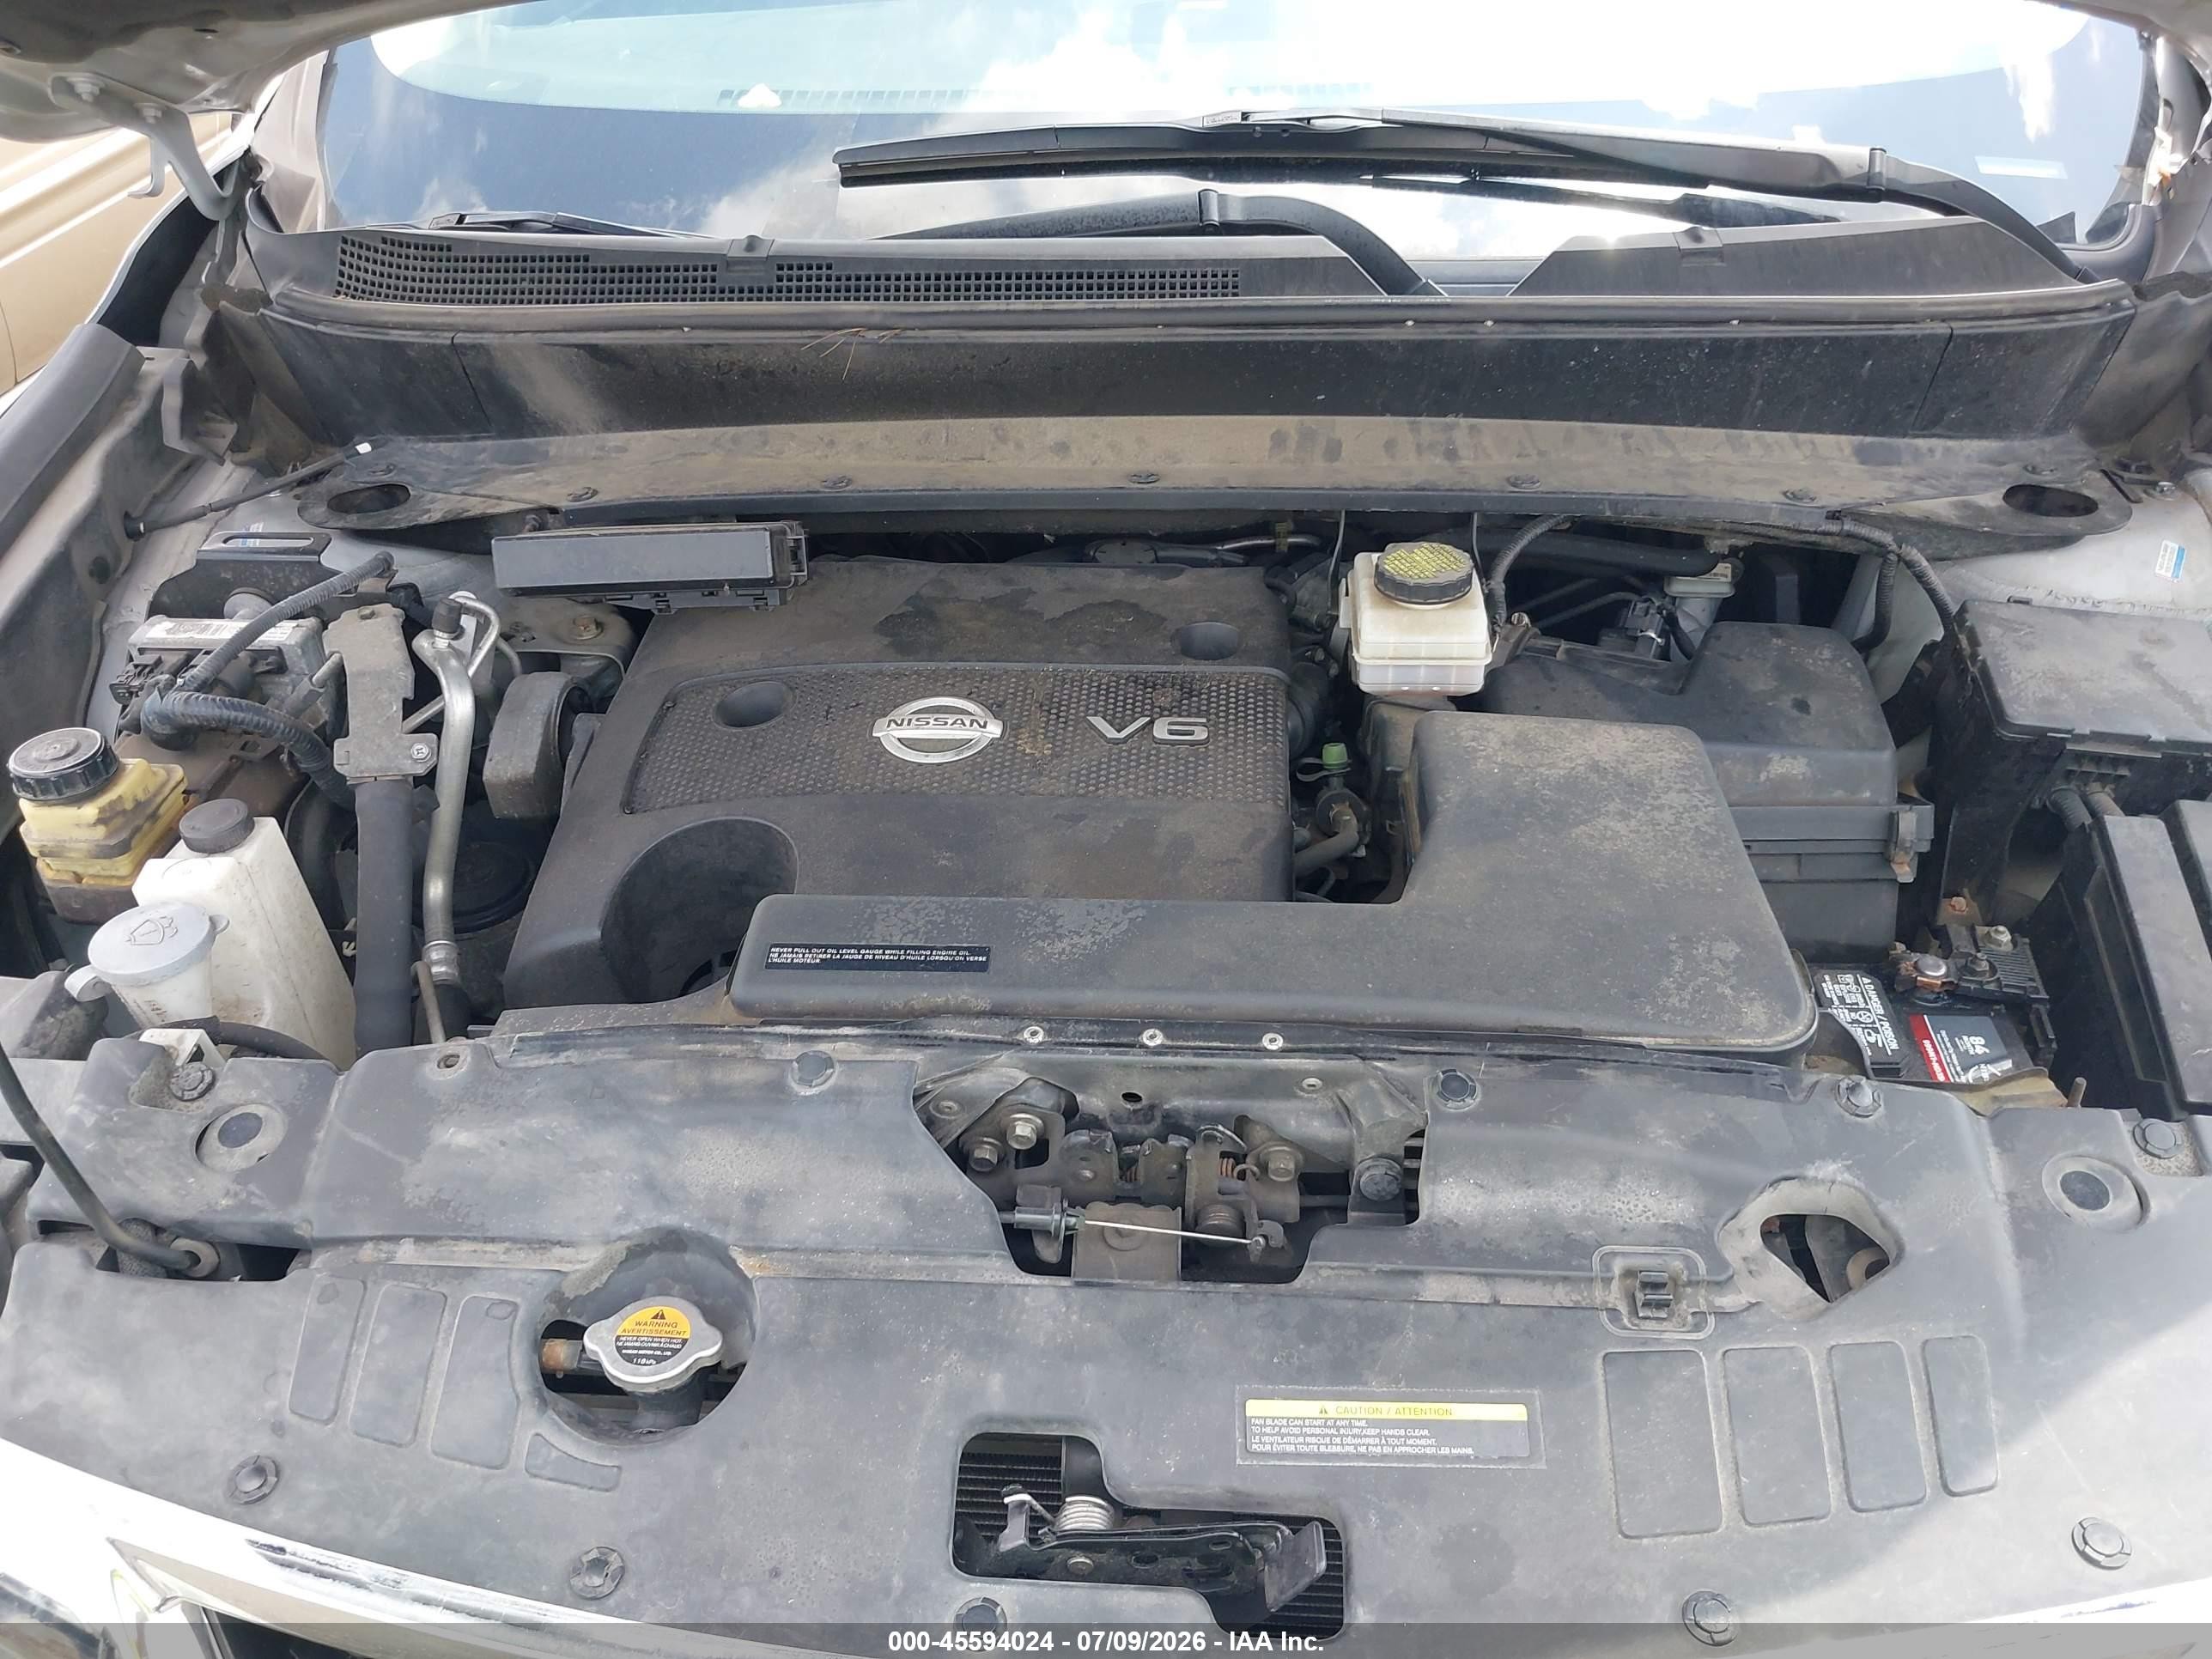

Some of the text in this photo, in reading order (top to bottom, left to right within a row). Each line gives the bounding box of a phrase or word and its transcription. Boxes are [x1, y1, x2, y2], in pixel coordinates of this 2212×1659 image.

[885, 716, 988, 729] NISSAN
[1086, 716, 1210, 744] V6
[1864, 984, 1885, 1015] DANGER
[1880, 1021, 1899, 1049] POISON
[1969, 1036, 1990, 1054] 84
[635, 1320, 678, 1328] WARNING
[621, 1328, 686, 1336] AVERTISSEMENT
[1335, 1406, 1382, 1415] CAUTION
[1395, 1407, 1453, 1416] ATTENTION
[1304, 1436, 1330, 1444] RISQUE
[1342, 1435, 1380, 1444] DÉMARRER
[1273, 1443, 1296, 1451] ÉVITER
[1394, 1445, 1436, 1454] APPROCHER
